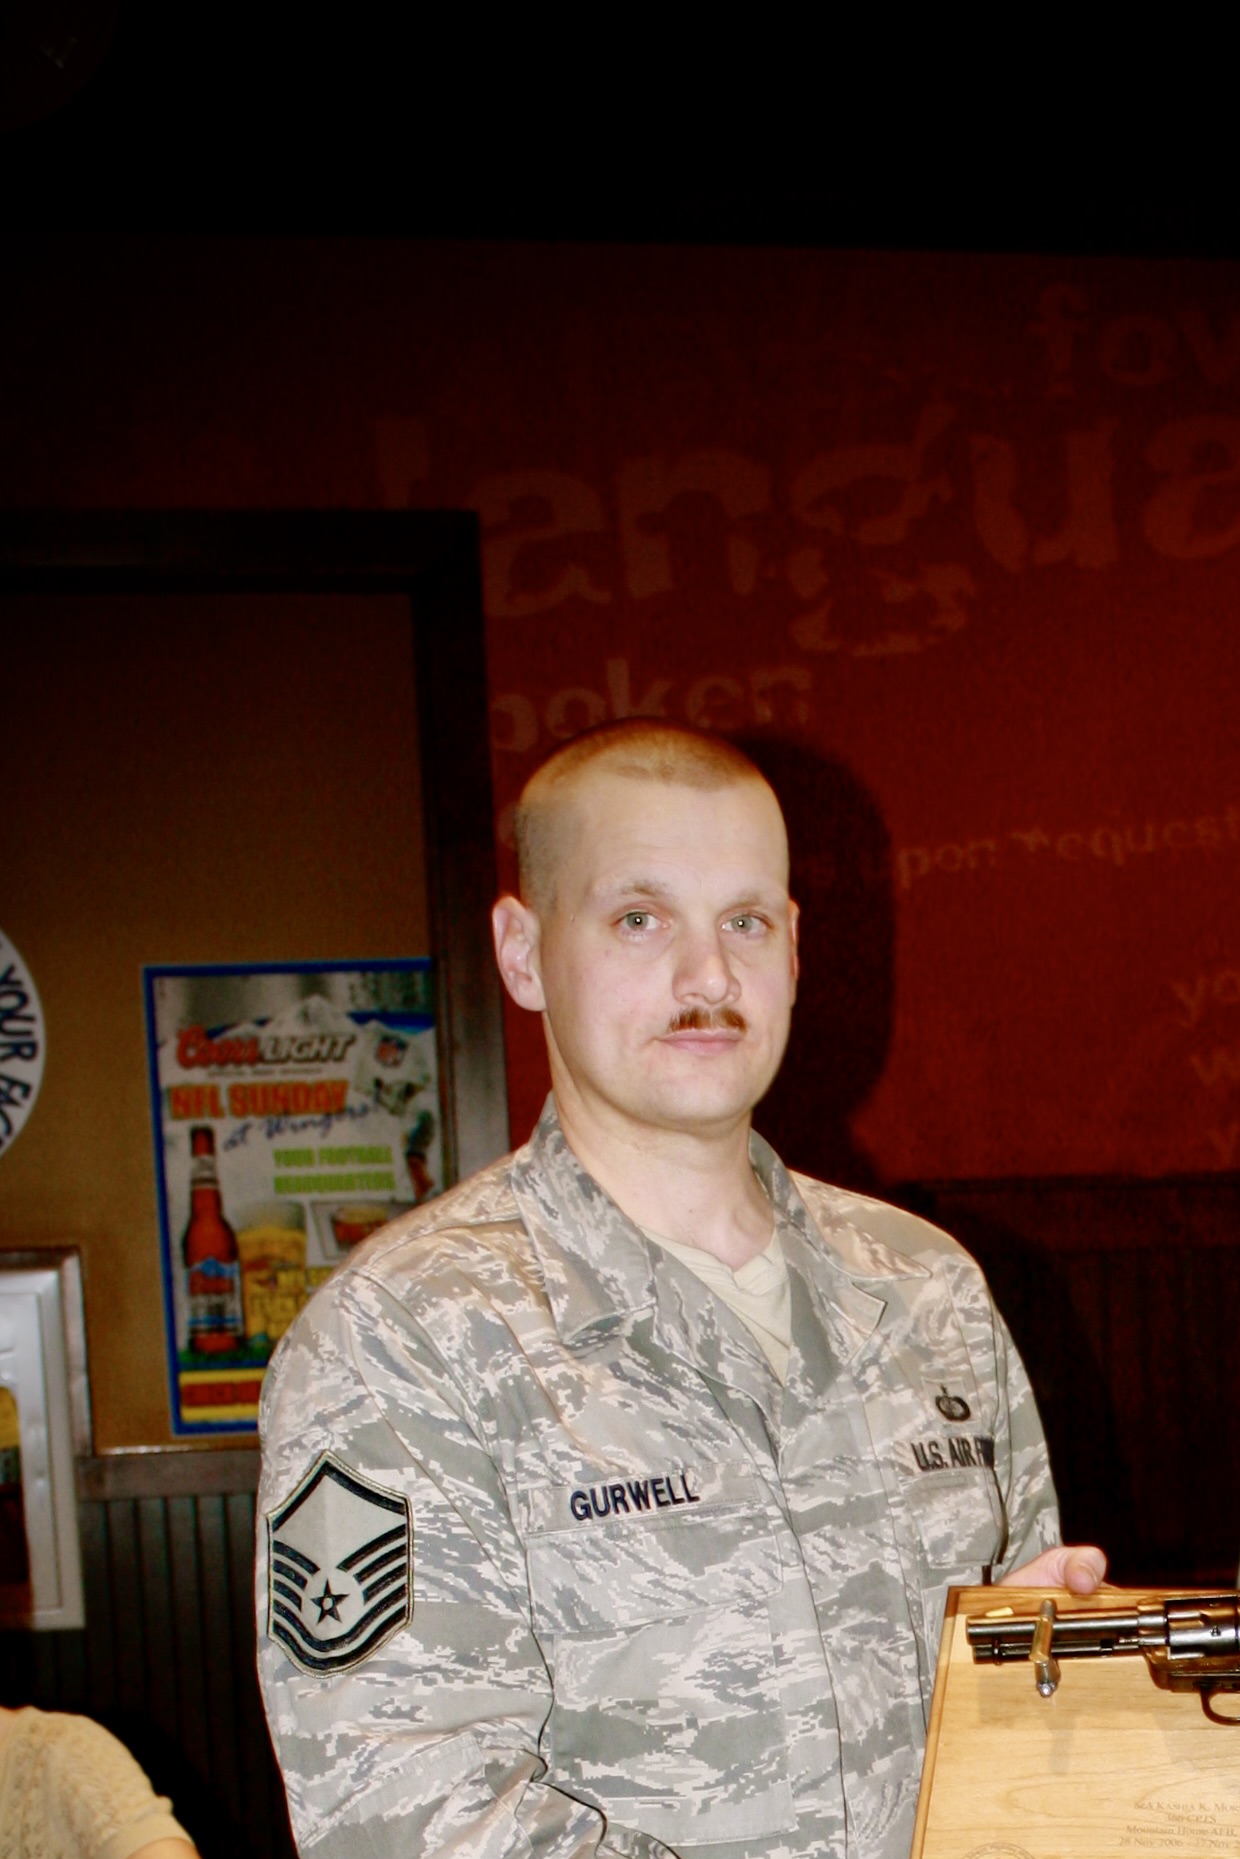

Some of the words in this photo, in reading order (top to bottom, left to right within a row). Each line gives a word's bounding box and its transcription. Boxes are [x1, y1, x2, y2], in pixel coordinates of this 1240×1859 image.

[258, 1033, 356, 1065] LIGHT
[227, 1079, 348, 1119] SUNDAY
[911, 1439, 949, 1473] U.S.
[569, 1474, 700, 1522] GURWELL
[1126, 1826, 1175, 1836] Mountain
